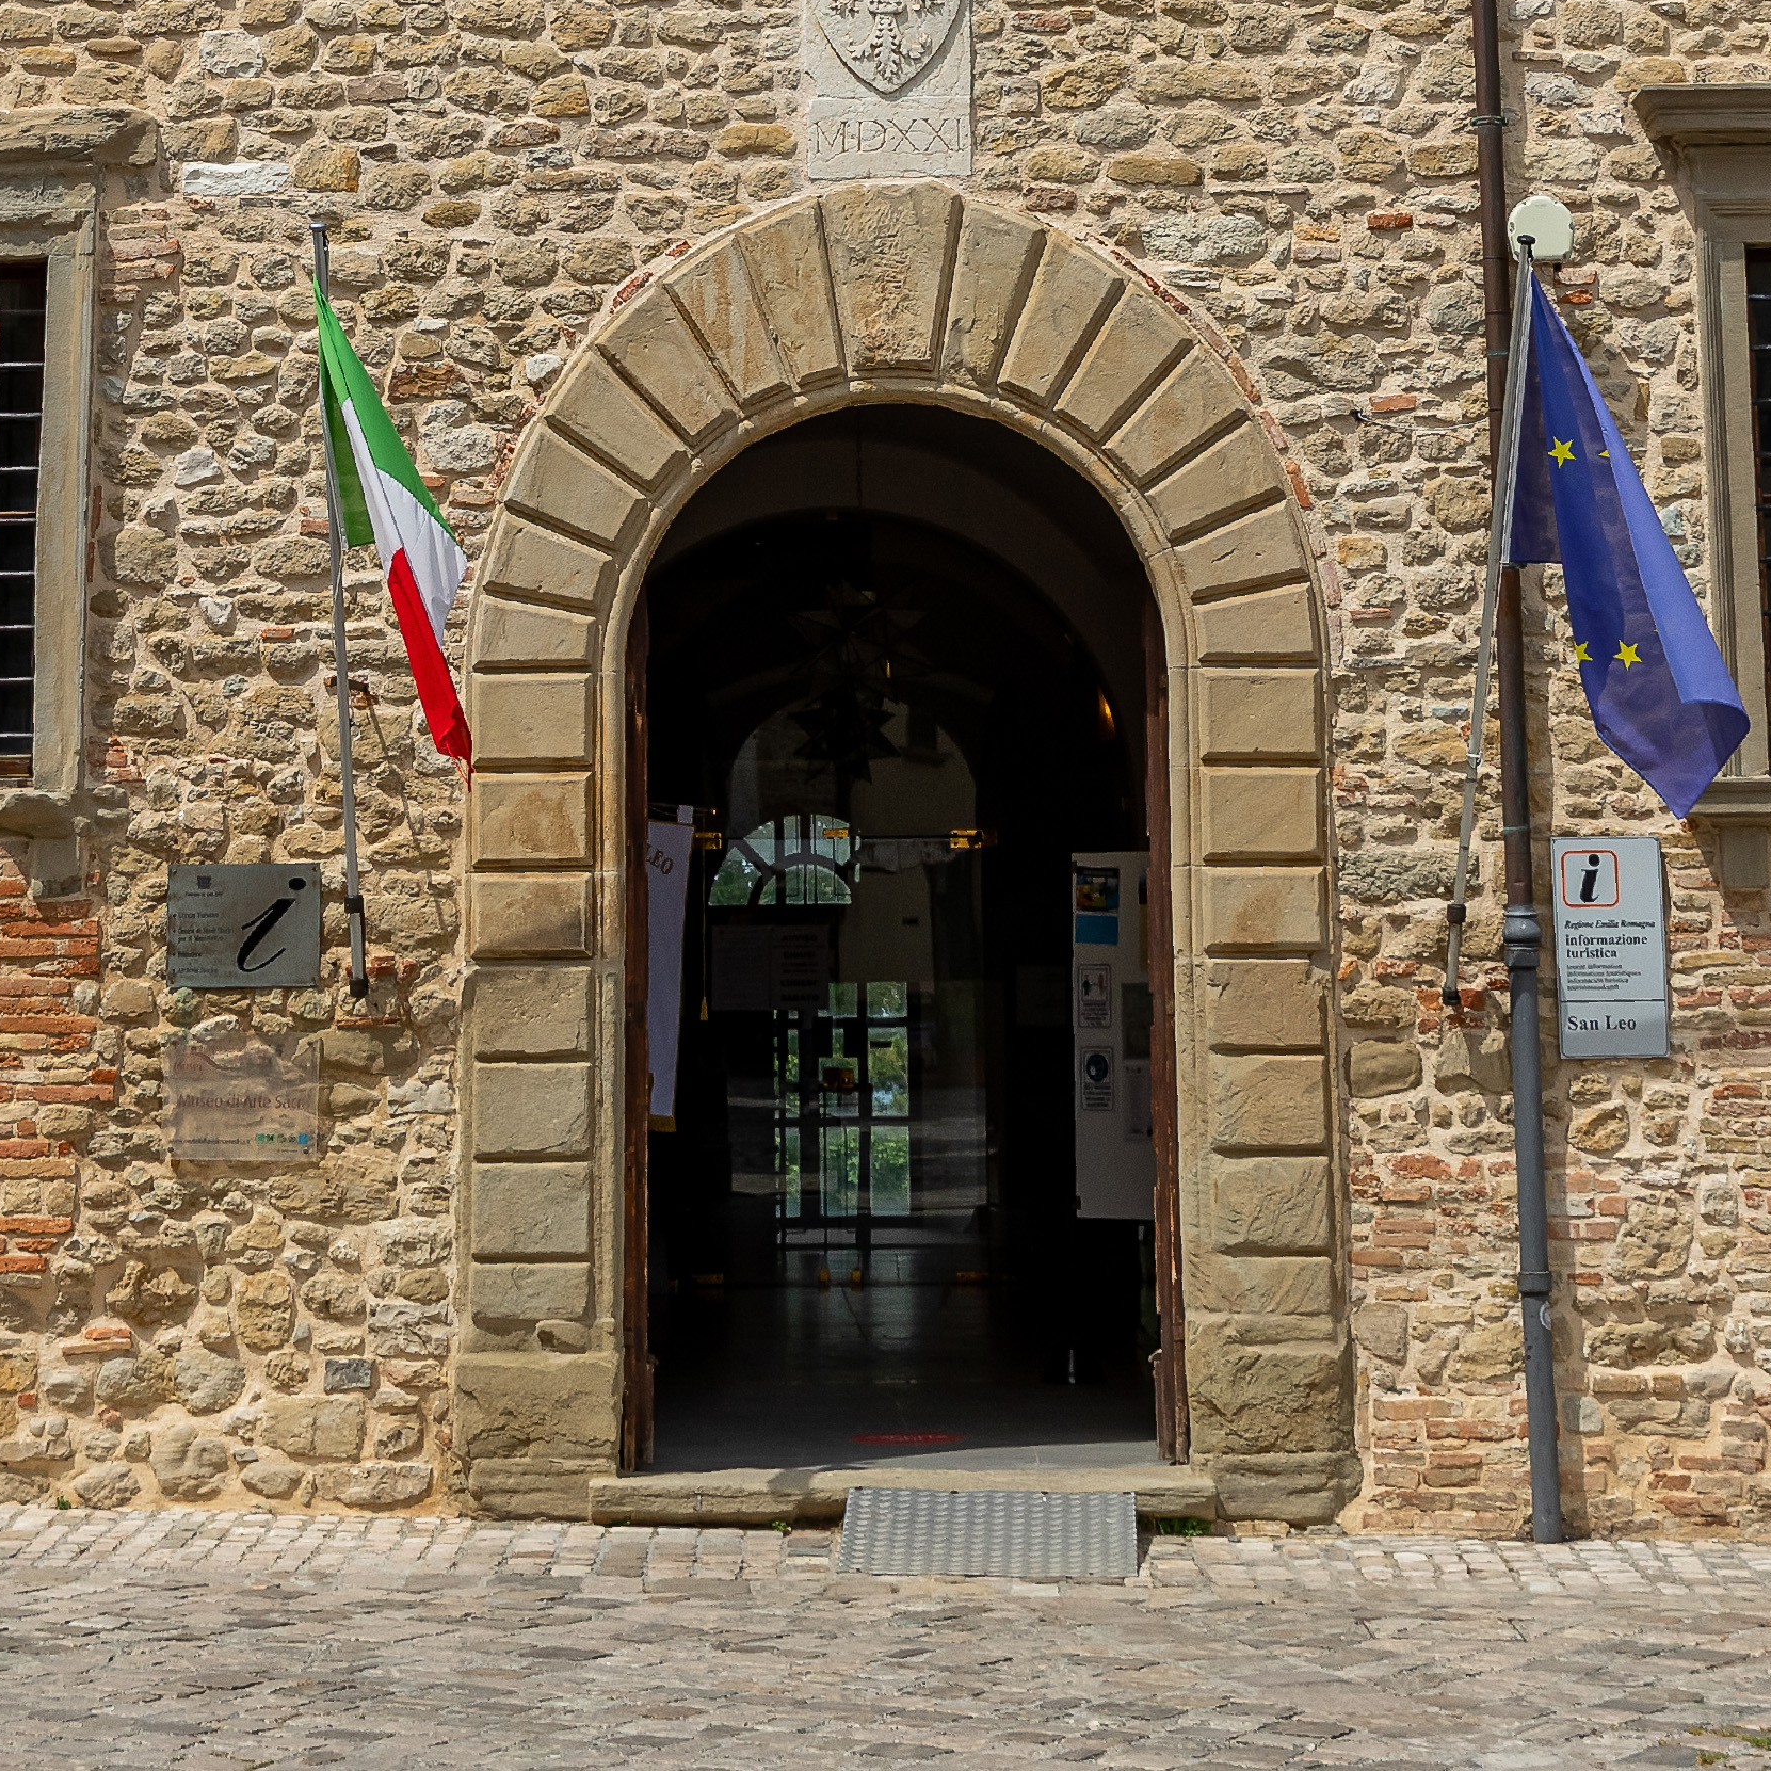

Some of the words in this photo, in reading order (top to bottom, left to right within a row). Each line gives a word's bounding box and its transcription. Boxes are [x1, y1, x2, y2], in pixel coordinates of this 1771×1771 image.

[813, 117, 966, 155] MDXXI
[1564, 919, 1594, 930] Regione
[1595, 919, 1619, 929] Emilia
[1621, 919, 1656, 930] Romagna
[1565, 934, 1648, 946] informazione
[1566, 947, 1617, 958] turistica
[1567, 1015, 1599, 1030] San
[1605, 1014, 1637, 1031] Leo
[178, 1094, 224, 1109] Museo
[227, 1094, 240, 1108] di
[242, 1094, 272, 1109] Arte
